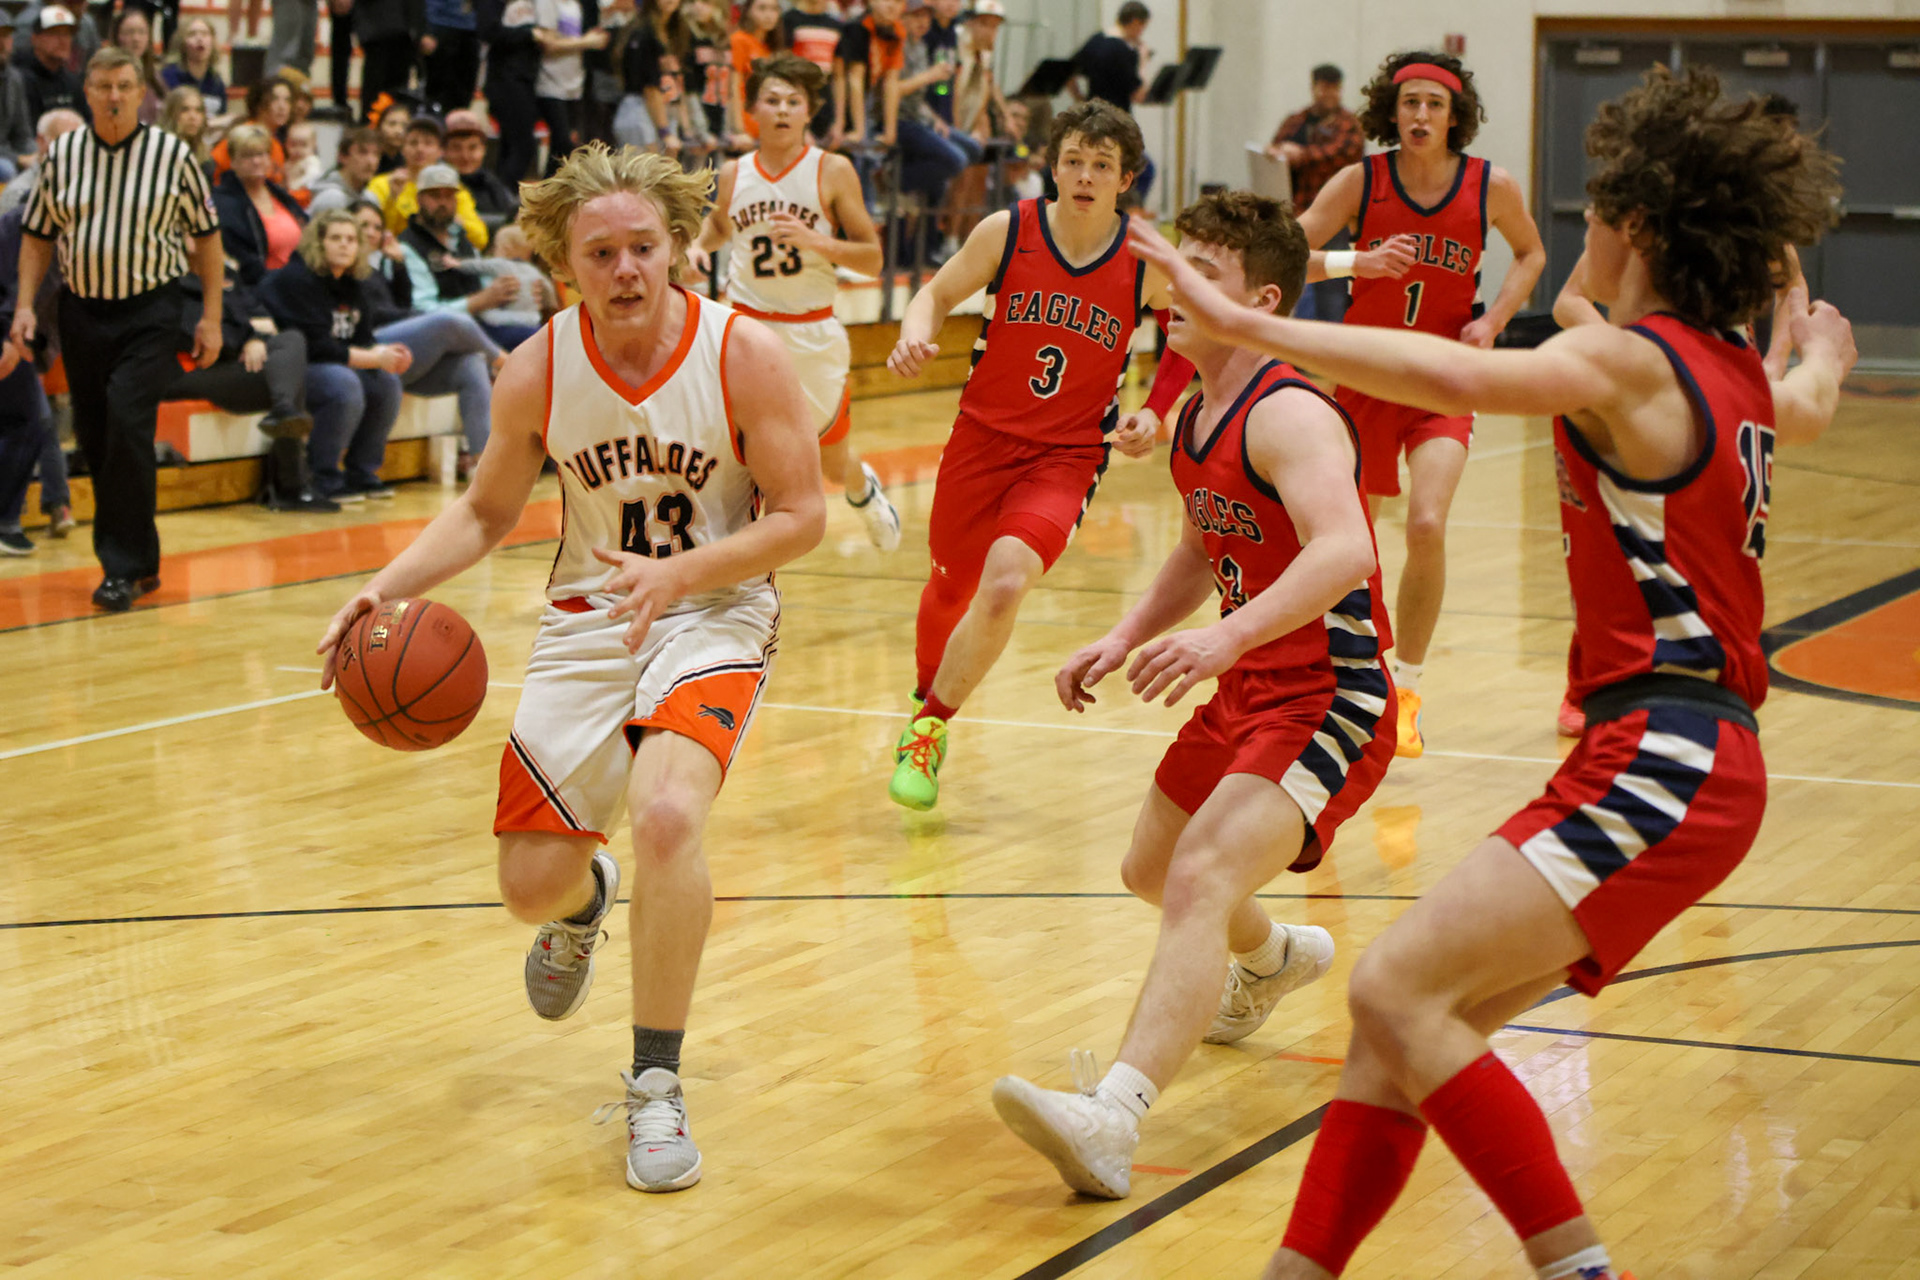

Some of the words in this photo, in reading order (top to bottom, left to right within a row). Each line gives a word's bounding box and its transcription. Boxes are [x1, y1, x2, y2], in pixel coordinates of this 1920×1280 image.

[751, 235, 804, 278] 23
[1005, 291, 1121, 352] EAGLES
[1404, 280, 1425, 327] 1
[1028, 344, 1068, 399] 3
[563, 434, 719, 493] UFFALOES
[618, 490, 697, 559] 43
